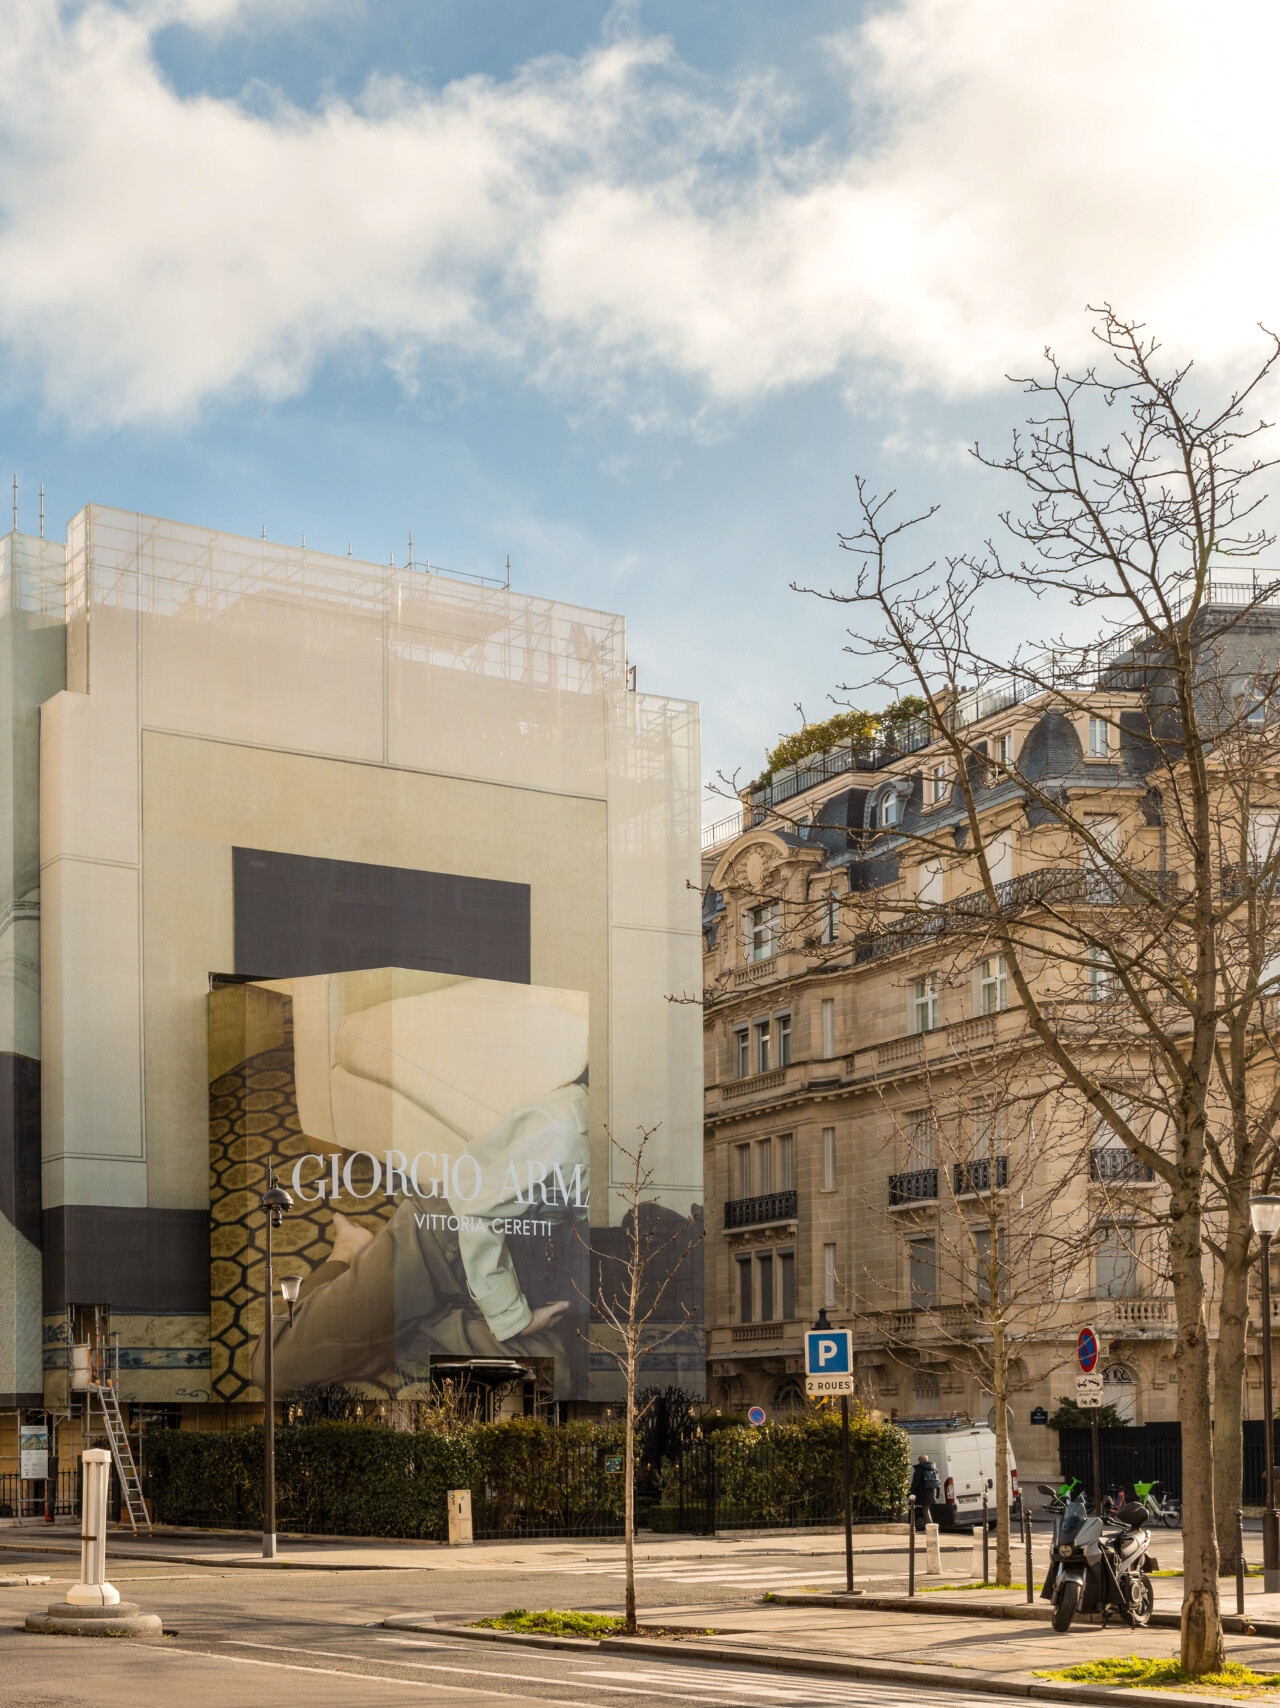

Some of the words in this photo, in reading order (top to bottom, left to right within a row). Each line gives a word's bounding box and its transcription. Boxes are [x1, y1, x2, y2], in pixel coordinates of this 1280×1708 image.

[291, 1149, 483, 1202] GIORGIO
[413, 1212, 488, 1233] VITTORIA
[491, 1217, 552, 1237] CERETTI
[818, 1340, 838, 1367] P
[808, 1382, 814, 1391] 2
[817, 1381, 851, 1390] ROUES
